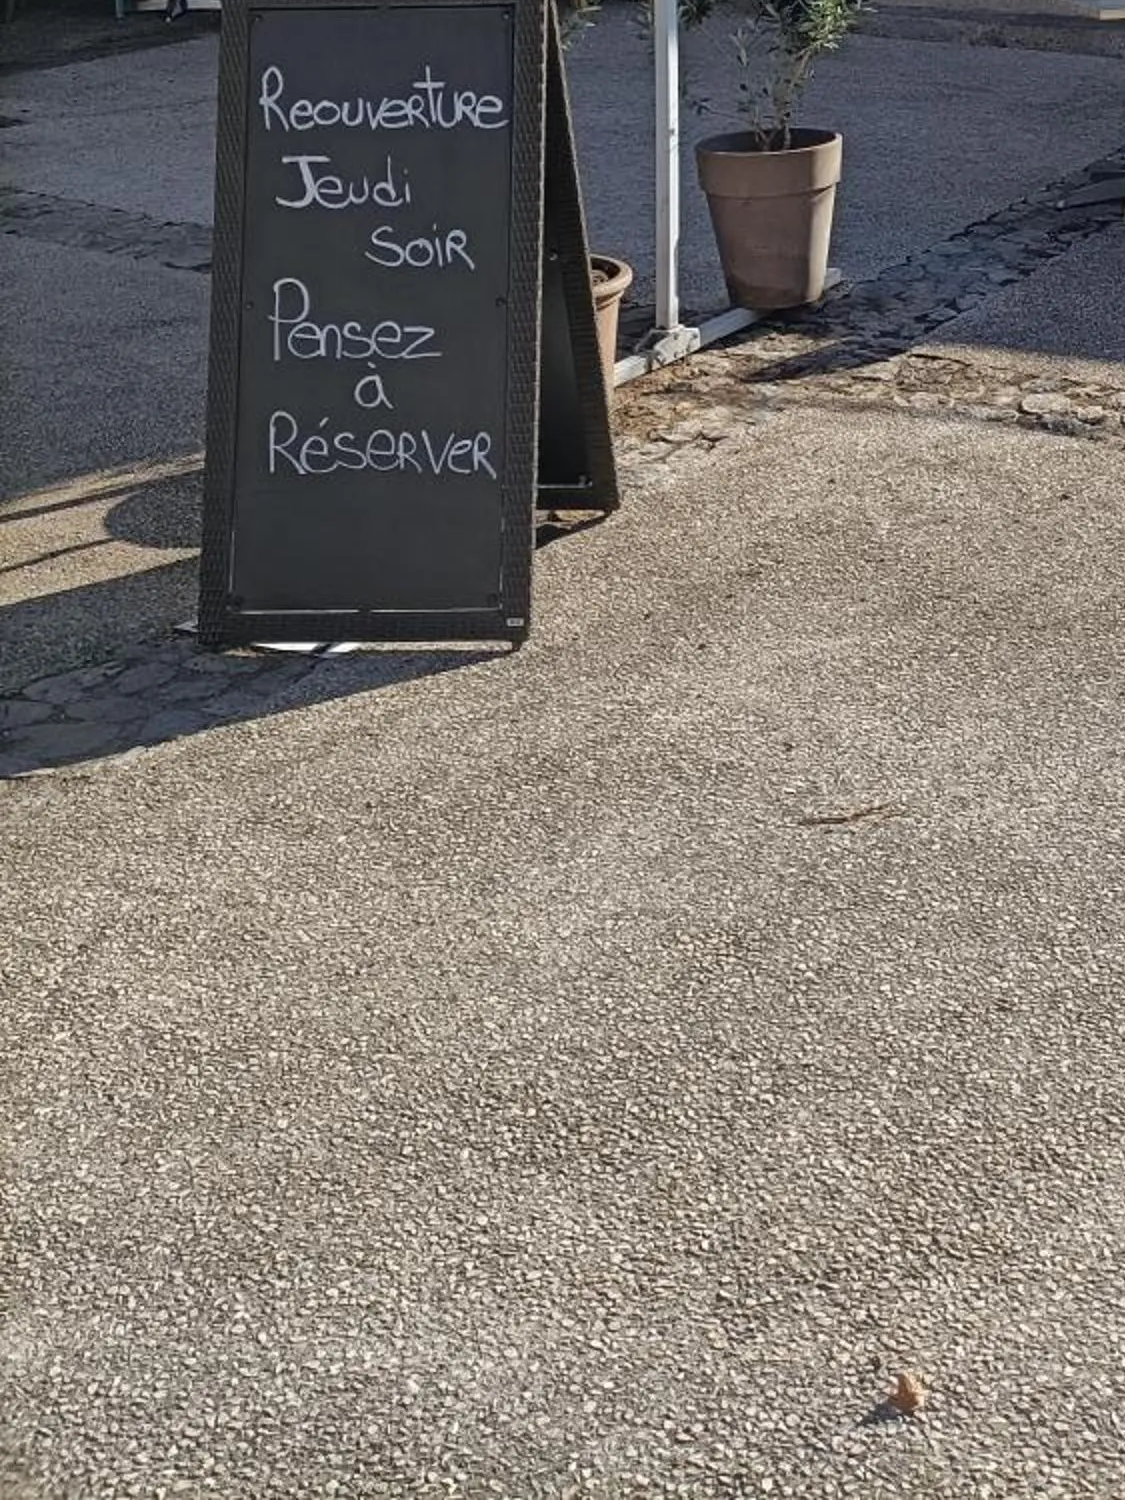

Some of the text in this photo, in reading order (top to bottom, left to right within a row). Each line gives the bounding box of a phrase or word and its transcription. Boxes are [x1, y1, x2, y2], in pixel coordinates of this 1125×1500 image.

[275, 155, 412, 209] Jeudi
[268, 277, 441, 361] Pensez
[354, 362, 393, 409] à
